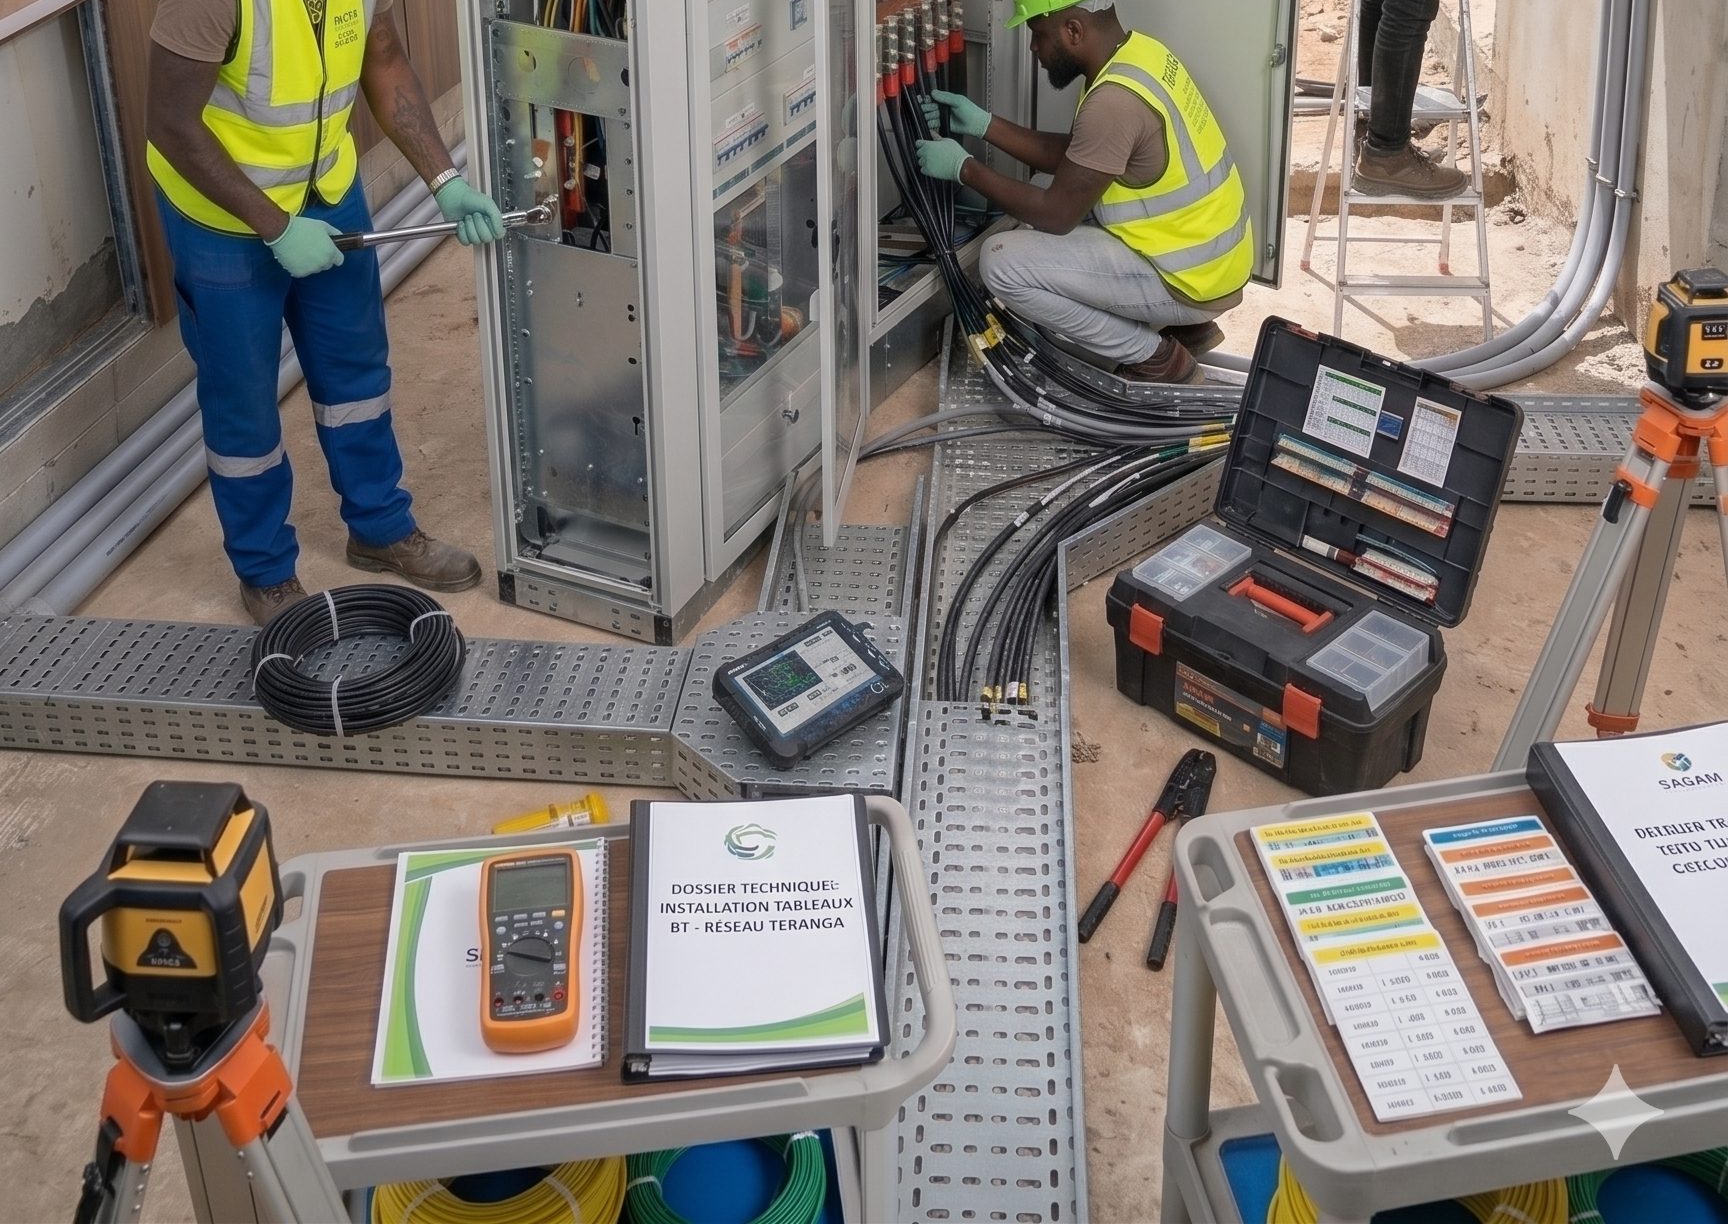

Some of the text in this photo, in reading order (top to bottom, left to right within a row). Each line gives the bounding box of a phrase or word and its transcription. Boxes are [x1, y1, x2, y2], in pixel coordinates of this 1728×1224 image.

[1658, 772, 1724, 790] SAGAM
[671, 883, 736, 895] DOSSIER
[660, 897, 854, 914] INSTALLATION TABLEAUX
[670, 921, 690, 933] BT
[704, 919, 764, 933] RÉSEAU
[768, 917, 845, 932] TERANGA
